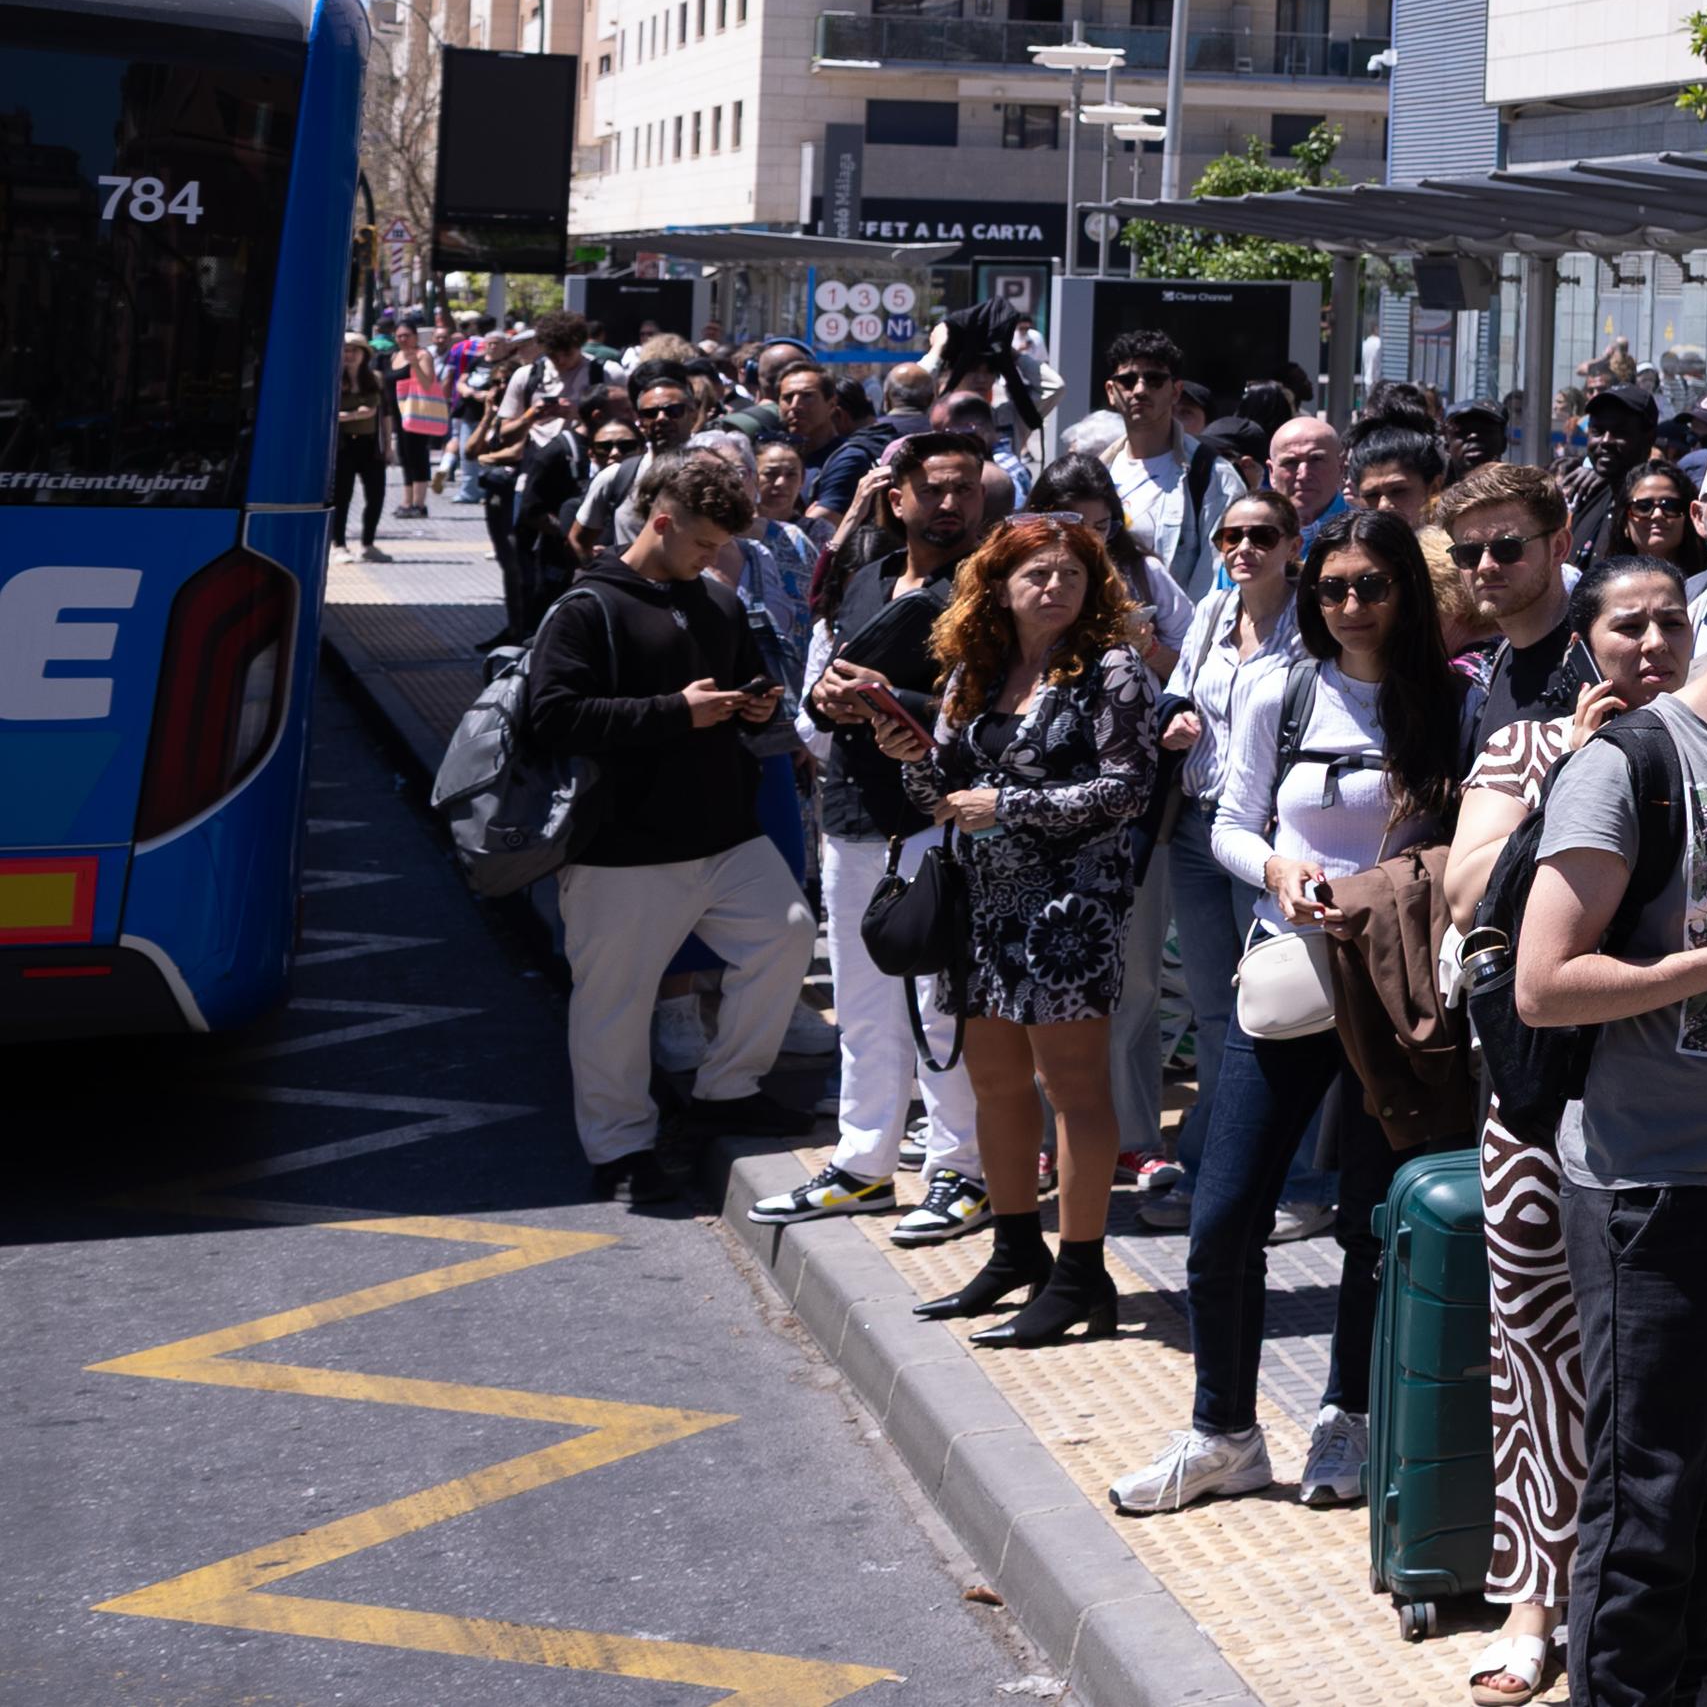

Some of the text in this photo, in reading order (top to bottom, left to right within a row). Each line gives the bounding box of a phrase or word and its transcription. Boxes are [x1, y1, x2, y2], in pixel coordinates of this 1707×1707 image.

[835, 153, 855, 205] Málaga
[98, 175, 204, 225] 784
[915, 222, 930, 238] A
[937, 223, 965, 239] LA
[972, 223, 1043, 241] CARTA
[826, 289, 906, 307] 1 3 5
[825, 319, 913, 337] 9 10 N1
[0, 471, 209, 495] EfficientHybrid
